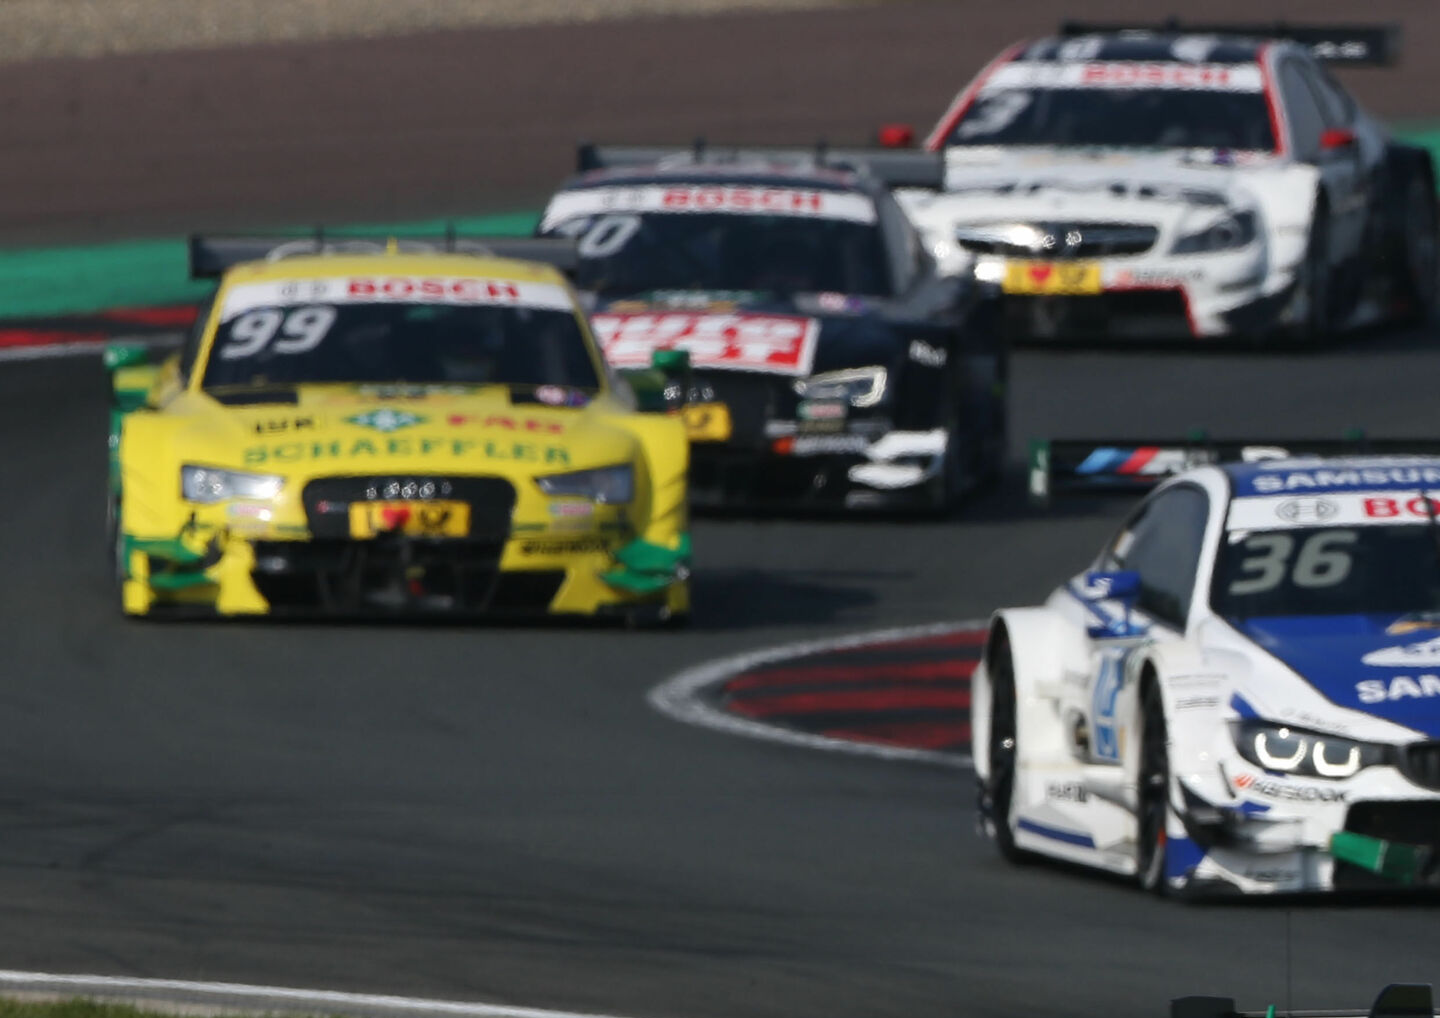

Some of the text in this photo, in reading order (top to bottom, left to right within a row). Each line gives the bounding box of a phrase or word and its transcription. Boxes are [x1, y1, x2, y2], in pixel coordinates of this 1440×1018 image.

[663, 189, 822, 211] BOSCH
[347, 280, 519, 300] BOSCH
[221, 306, 336, 360] 99
[244, 438, 570, 466] SCHAEFFLER
[1229, 531, 1360, 596] 36
